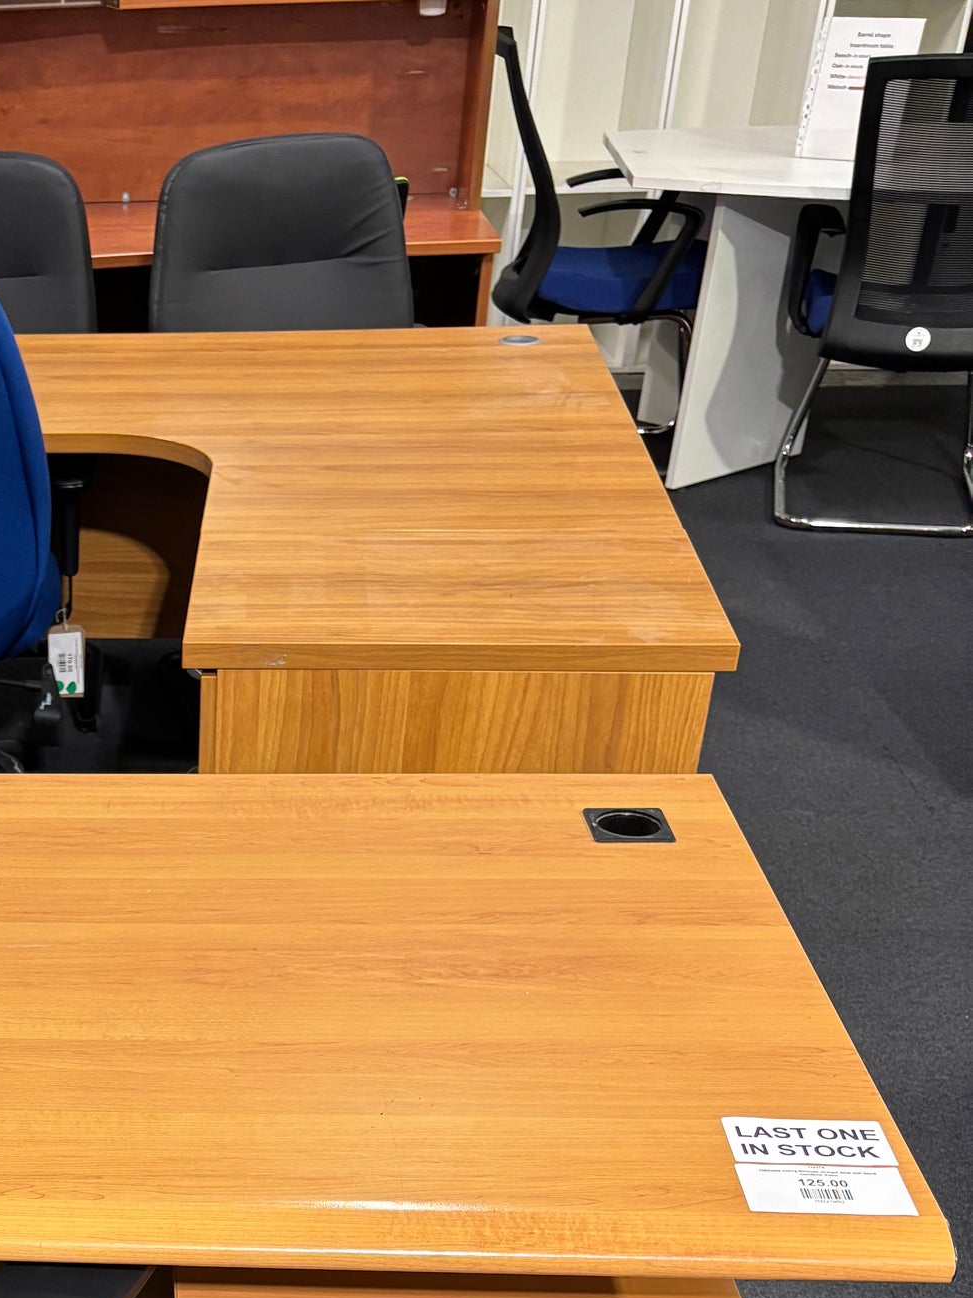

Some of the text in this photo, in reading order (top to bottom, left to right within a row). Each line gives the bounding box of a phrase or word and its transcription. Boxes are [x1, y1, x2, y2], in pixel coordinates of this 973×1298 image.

[734, 1126, 880, 1141] LAST ONE
[740, 1143, 880, 1158] IN STOCK
[798, 1179, 848, 1188] 125.00
